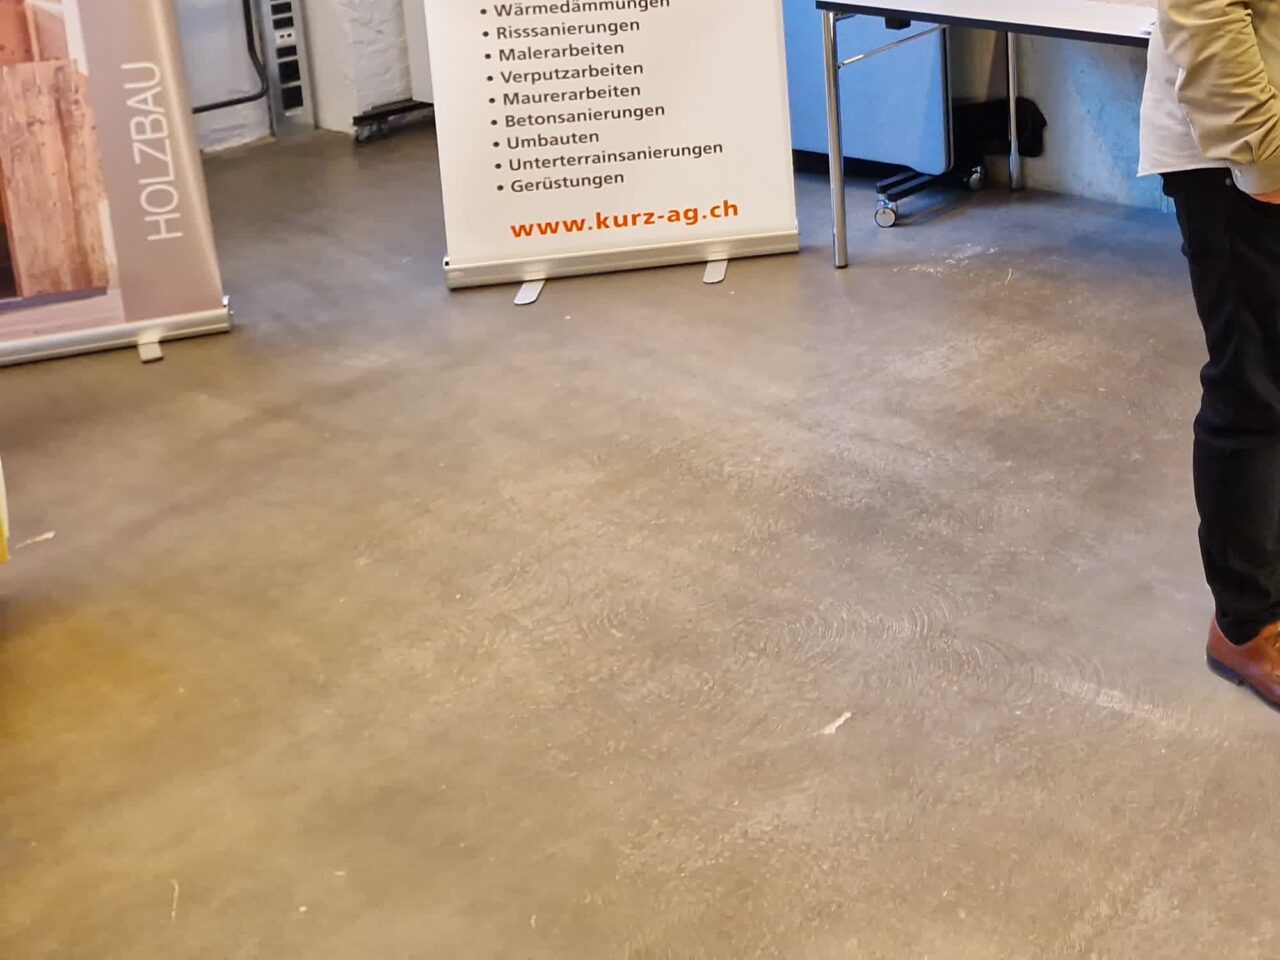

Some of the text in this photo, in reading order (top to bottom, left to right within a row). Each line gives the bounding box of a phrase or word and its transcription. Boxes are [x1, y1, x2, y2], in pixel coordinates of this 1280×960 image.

[497, 20, 641, 40] Risssanierungen
[499, 43, 625, 62] Malerarbeiten
[500, 63, 644, 85] Verputzarbeiten
[503, 86, 641, 106] Maurerarbeiten
[505, 104, 665, 128] Betonsanierungen
[120, 61, 184, 240] HOLZBAU
[507, 131, 600, 150] Umbauten
[509, 142, 723, 171] Unterterrainsanierungen
[511, 172, 625, 193] Gerüstungen
[510, 200, 739, 238] www.kurz-ag.ch
